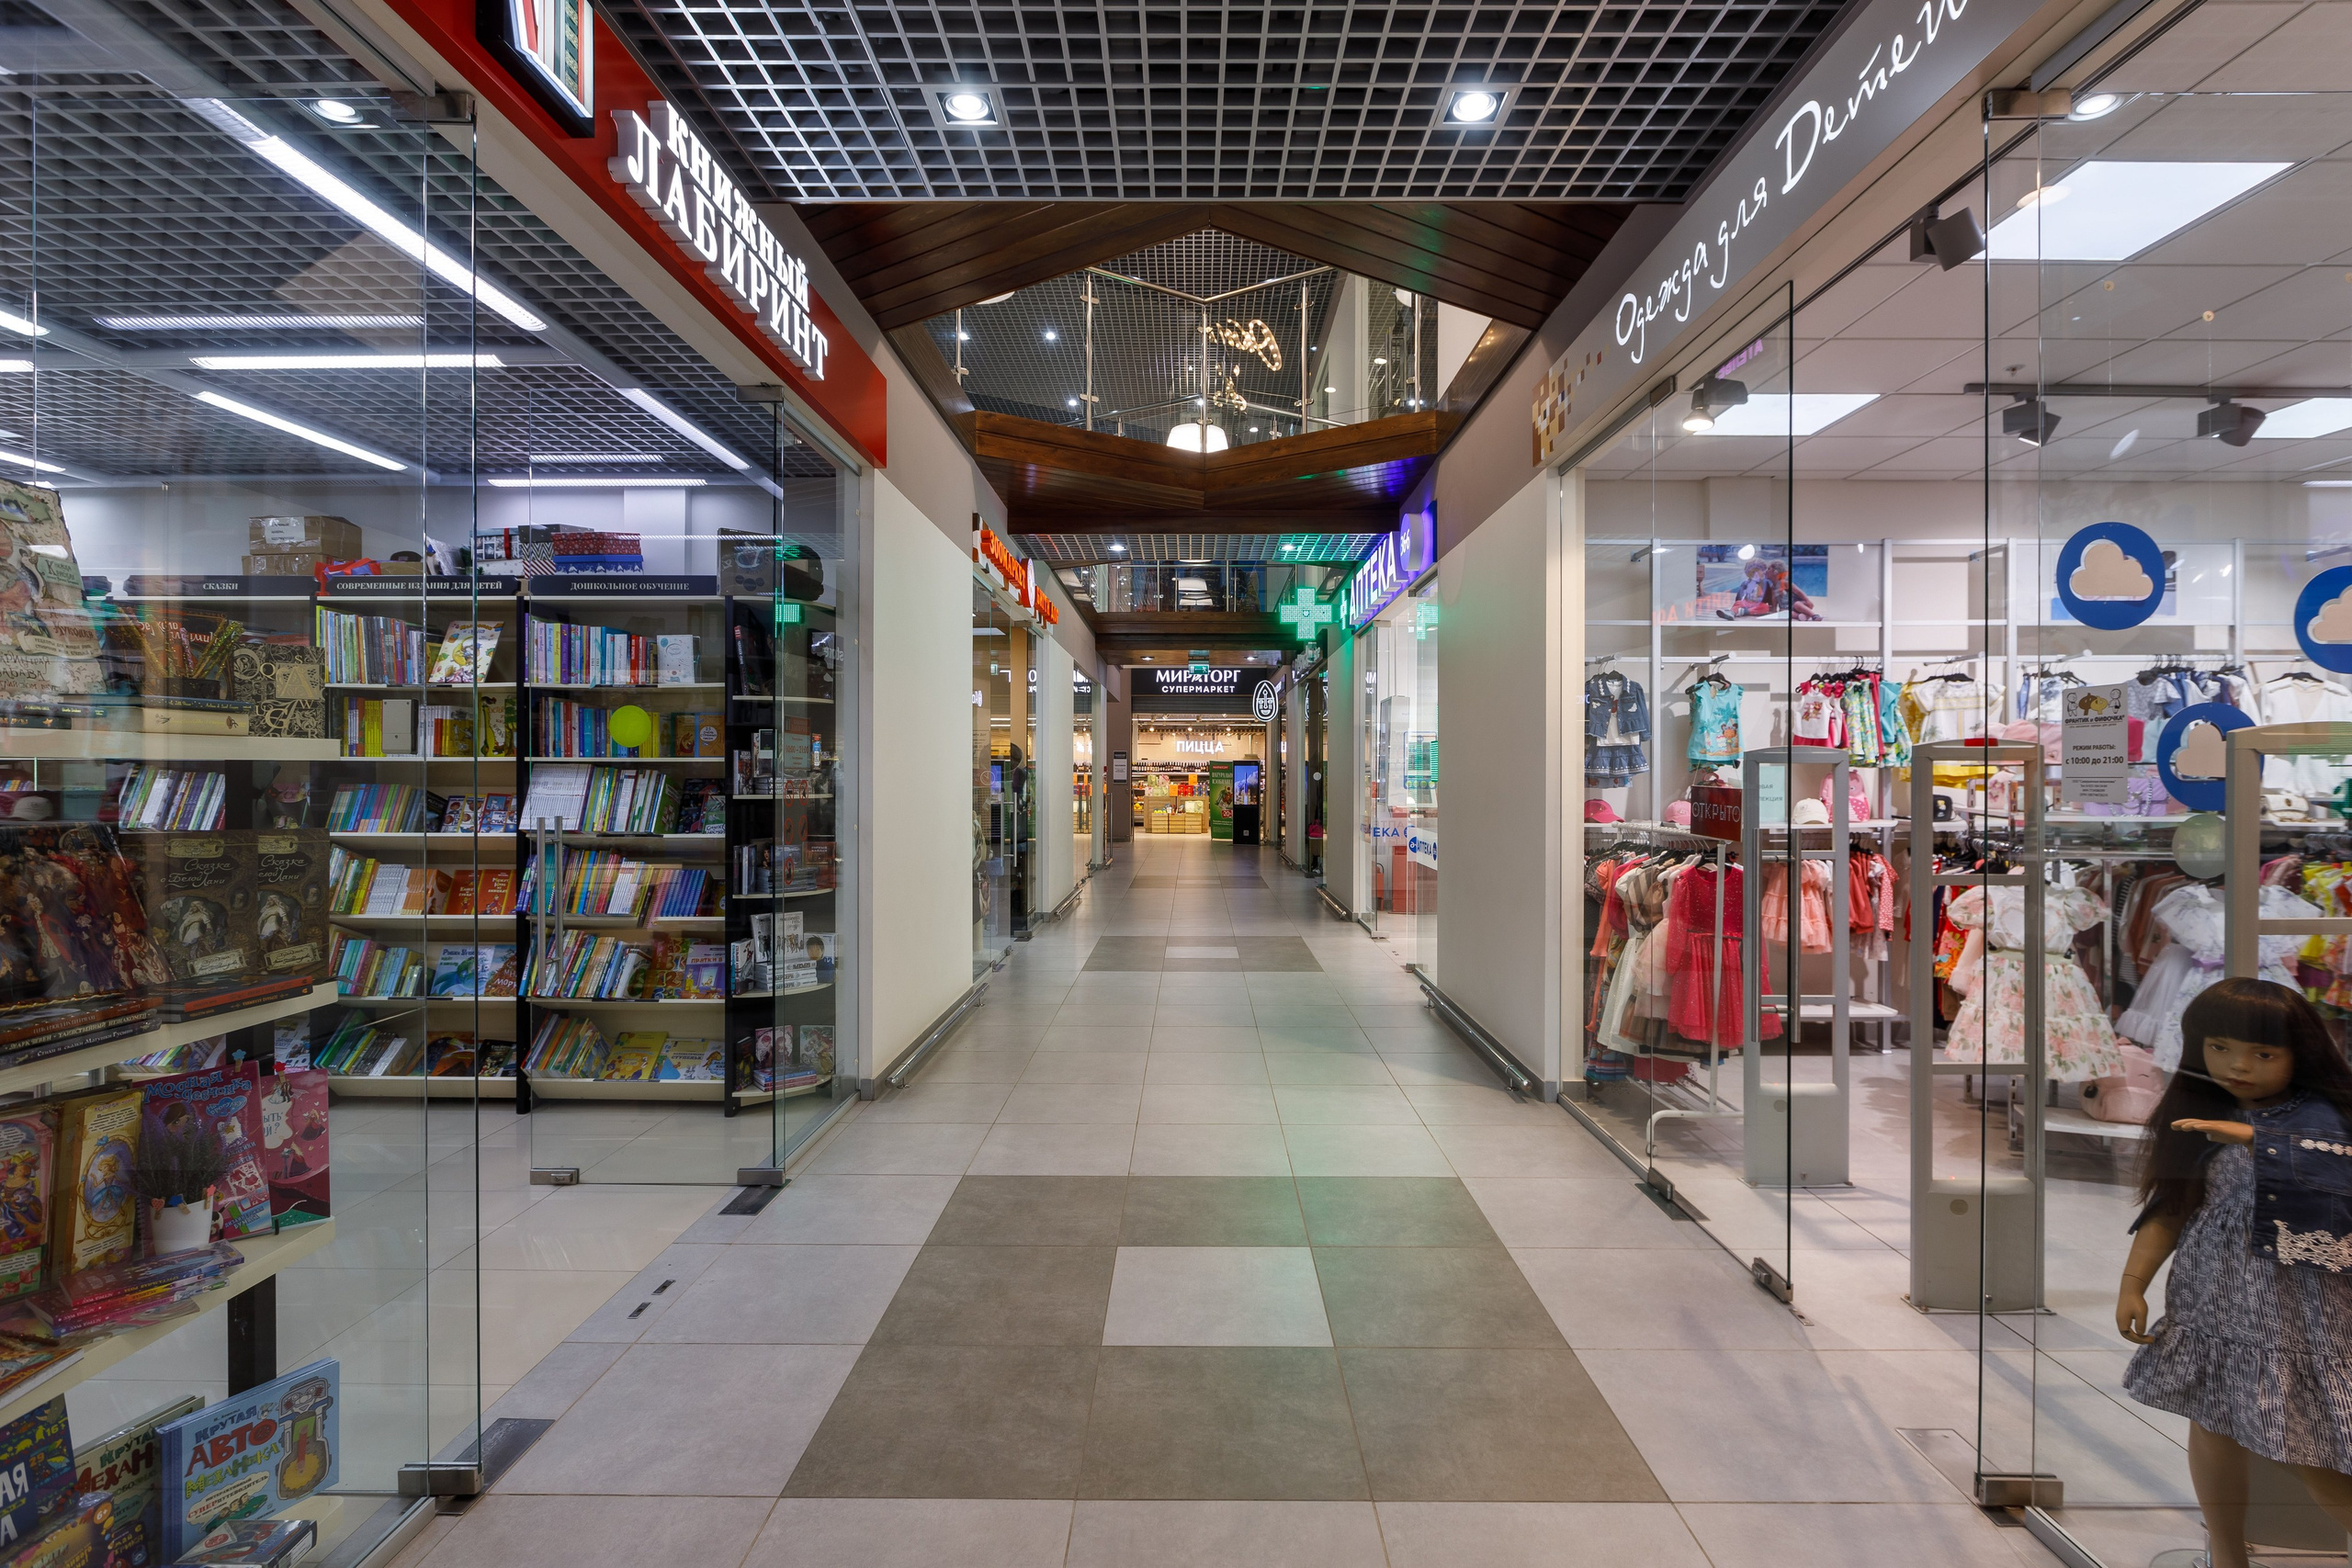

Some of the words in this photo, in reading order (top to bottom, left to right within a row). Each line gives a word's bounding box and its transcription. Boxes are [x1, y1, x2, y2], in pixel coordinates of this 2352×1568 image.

[662, 100, 810, 314] КНИЖНЫЙ
[617, 109, 830, 382] ЛАБИРИНТ
[1615, 241, 1708, 365] Одежда
[1710, 175, 1768, 289] для
[202, 581, 239, 591] СКАЗКИ
[336, 581, 407, 591] СОВРЕМЕННЫЕ
[408, 581, 450, 591] ИЗДАНИЯ
[451, 581, 470, 592] ДЛЯ
[471, 581, 503, 592] ДЕТЕЙ
[570, 581, 637, 592] ДОШКОЛЬНОЕ
[639, 581, 690, 591] ОБУЧЕНИЕ
[1350, 531, 1396, 626] АПТЕКА
[1156, 670, 1241, 683] МИРАТОРГ
[1161, 685, 1236, 694] СУПЕРМАРКЕТ
[1176, 740, 1225, 754] ПИЦЦА
[2071, 756, 2090, 764] 10:00
[2102, 756, 2124, 764] 21:00
[1691, 802, 1741, 823] ОТКРЫТО
[185, 858, 237, 874] Сказка
[165, 872, 202, 888] Белой
[192, 872, 226, 888] Лани
[58, 1021, 107, 1038] ТАИНСТВЕННЫЙ
[144, 1070, 223, 1102] Модная
[175, 1077, 253, 1103] девчонка
[233, 1213, 260, 1230] БУМАГА
[195, 1404, 257, 1445] КРУТАЯ
[185, 1419, 278, 1478] АВТО
[74, 1441, 154, 1495] МЕХАН
[186, 1442, 280, 1500] МЕХАНИКА
